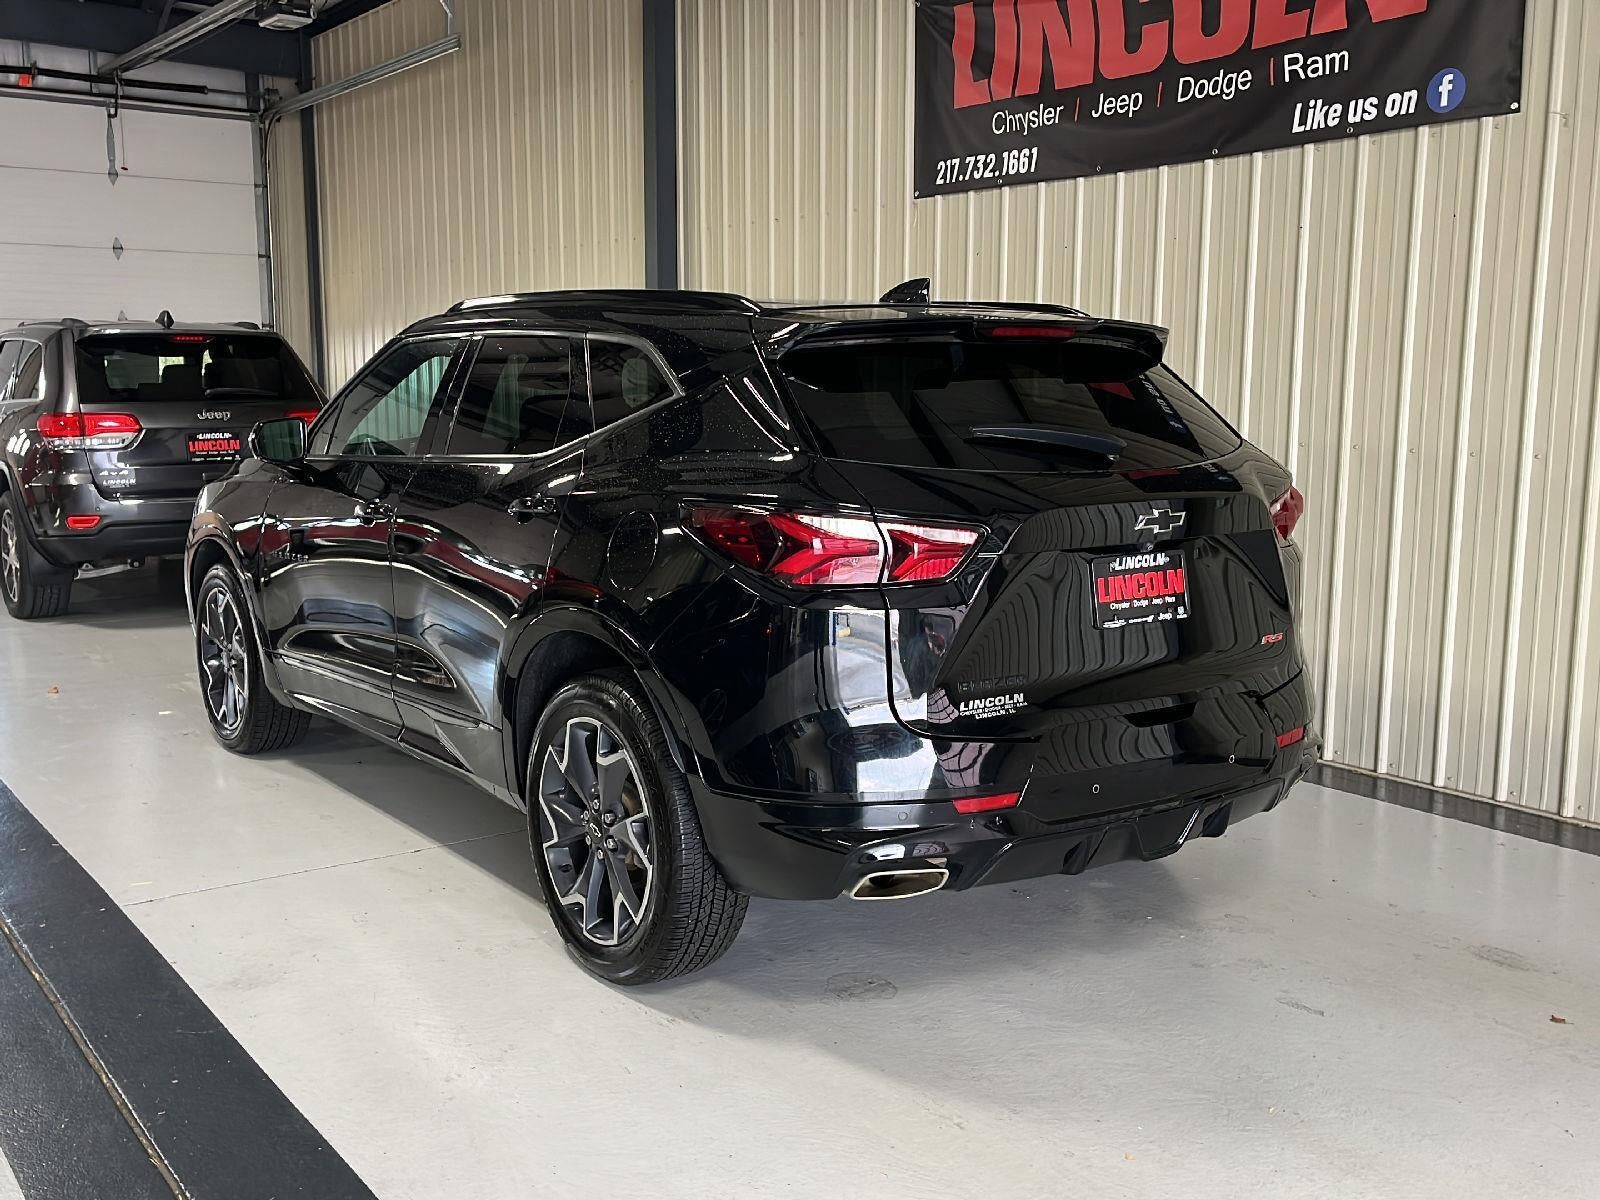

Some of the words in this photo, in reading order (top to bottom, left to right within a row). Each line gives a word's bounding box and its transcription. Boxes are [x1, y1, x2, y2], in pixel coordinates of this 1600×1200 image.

[953, 0, 1428, 109] LINCO
[992, 103, 1064, 135] Chrysler
[1092, 91, 1143, 118] Jeep
[1177, 68, 1252, 103] Dodge
[1283, 50, 1349, 83] Ram
[1291, 102, 1340, 134] Like
[1347, 97, 1378, 124] us
[1384, 88, 1418, 115] on
[935, 146, 1039, 185] 217.732.1661
[197, 409, 231, 421] Jeep
[198, 432, 230, 440] LINCOLN
[188, 439, 241, 453] LINCOLN
[1114, 552, 1166, 571] LINCOLN
[1097, 568, 1185, 603] LINCOLN
[1110, 602, 1130, 610] Chrysler
[1132, 599, 1149, 607] Dodge
[1152, 597, 1163, 605] Jeep
[1158, 612, 1173, 620] Jeep
[1261, 632, 1283, 645] RS
[959, 692, 1025, 712] LINCOLN
